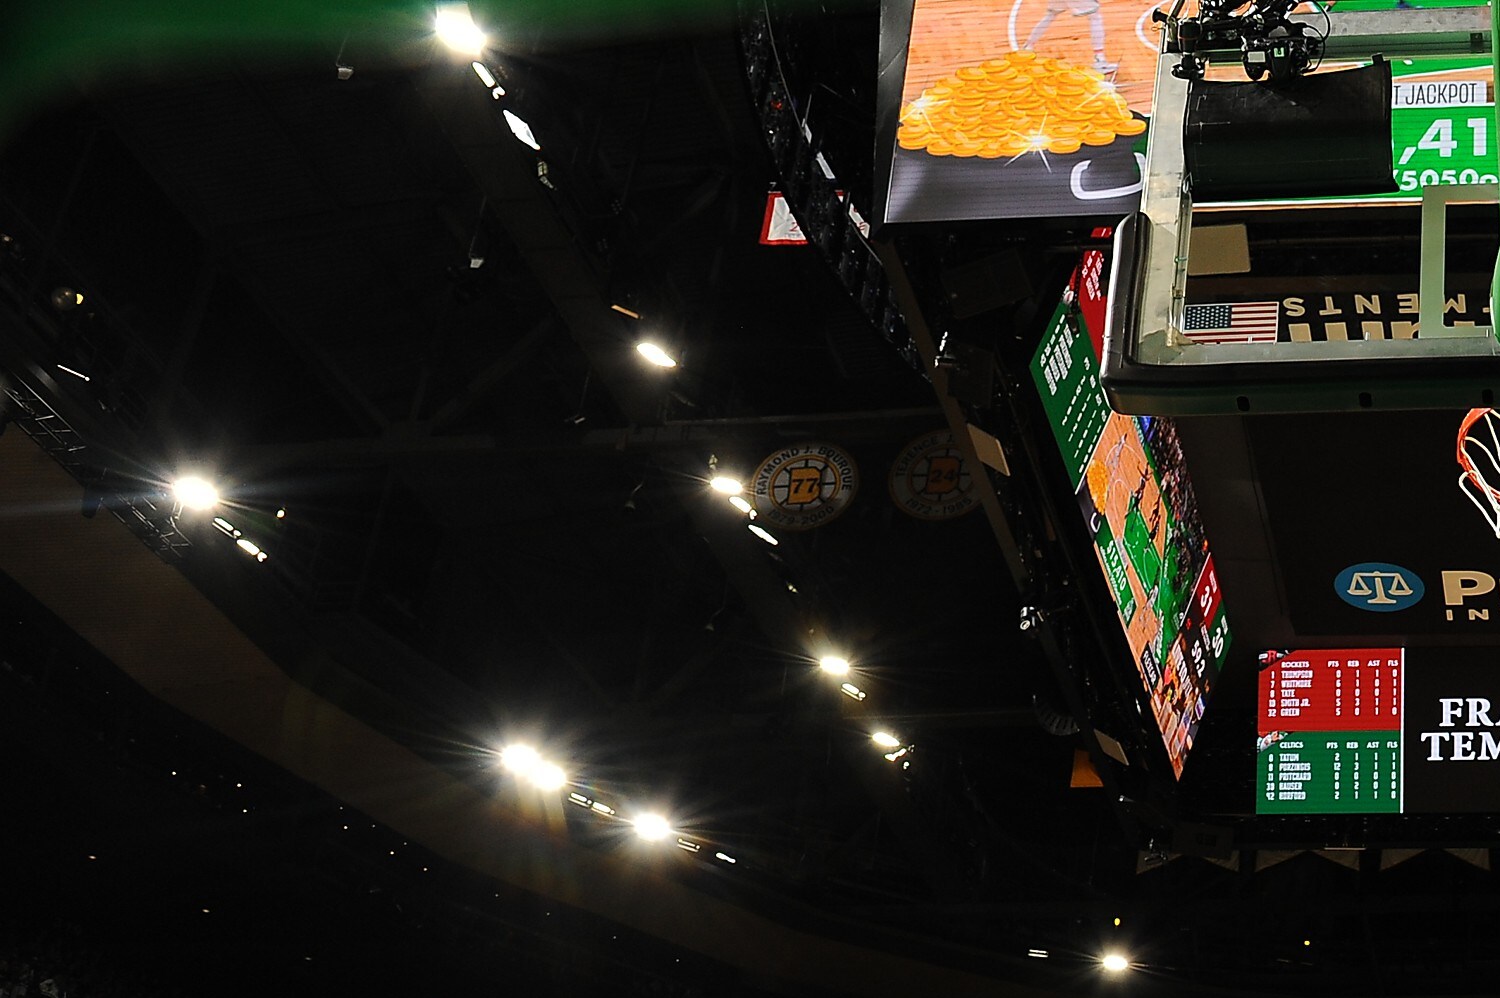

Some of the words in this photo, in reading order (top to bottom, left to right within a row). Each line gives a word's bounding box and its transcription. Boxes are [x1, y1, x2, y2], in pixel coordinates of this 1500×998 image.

[1405, 83, 1477, 105] JACKPOT
[756, 447, 799, 495] RAYMOND
[818, 447, 854, 491] BOURQUE
[793, 478, 818, 494] 77
[1366, 741, 1380, 749] AST
